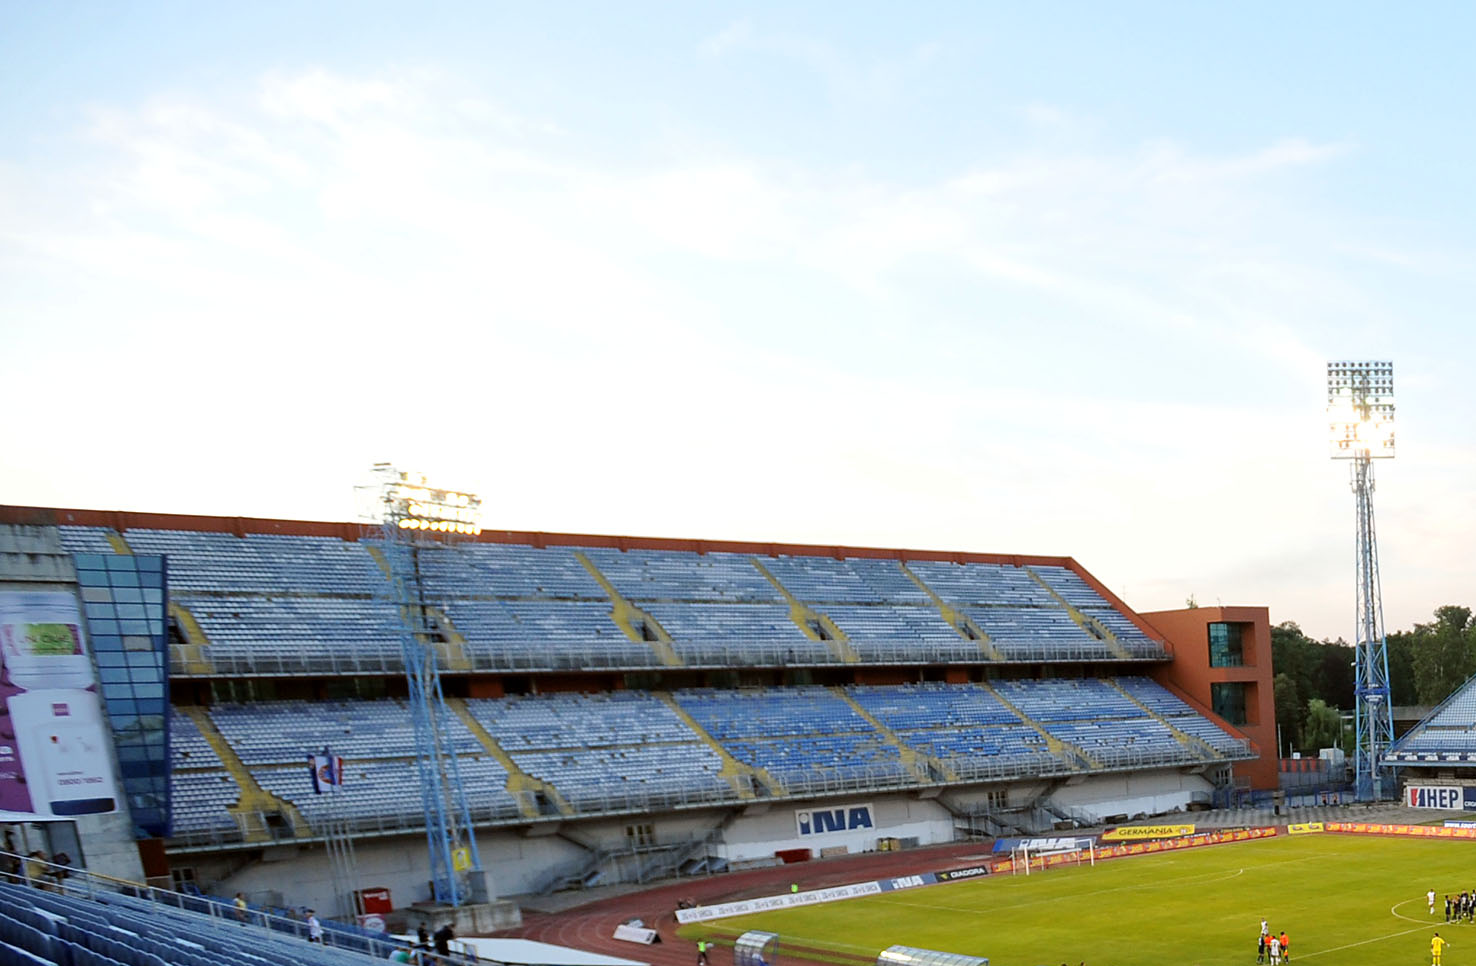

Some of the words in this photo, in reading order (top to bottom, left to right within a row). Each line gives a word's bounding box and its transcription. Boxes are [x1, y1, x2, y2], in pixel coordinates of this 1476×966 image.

[1429, 789, 1459, 808] HEP
[1118, 828, 1173, 836] GERMANIA
[950, 866, 985, 878] DIADORA
